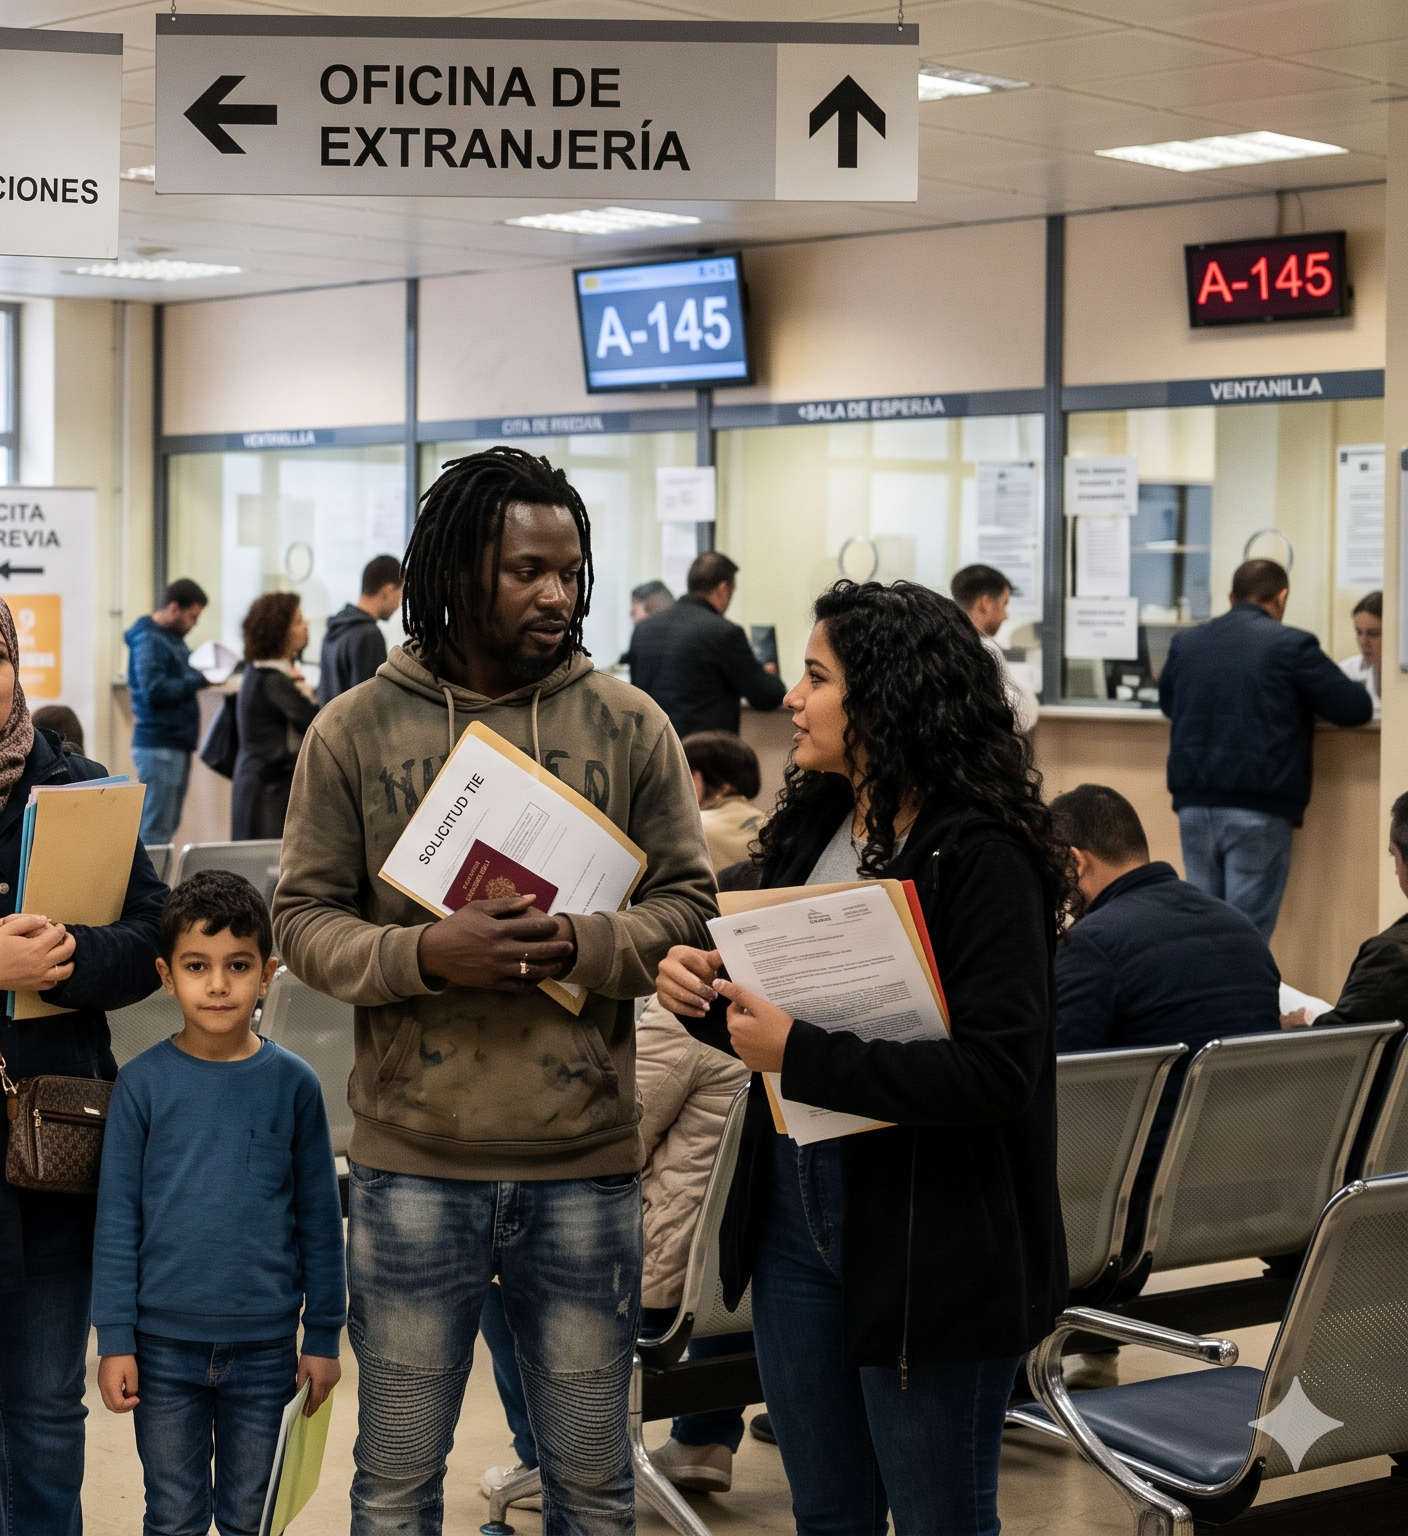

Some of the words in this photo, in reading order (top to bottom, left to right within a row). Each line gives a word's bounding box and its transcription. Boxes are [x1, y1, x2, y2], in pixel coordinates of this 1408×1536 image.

[319, 63, 537, 108] OFICINA
[552, 67, 622, 108] DE
[320, 119, 691, 172] EXTRANJERÍA
[1198, 251, 1333, 305] A-145
[596, 295, 732, 359] A-145
[1210, 378, 1323, 401] VENTANILLA
[418, 795, 469, 865] SOLICITUD
[463, 772, 485, 795] TIE
